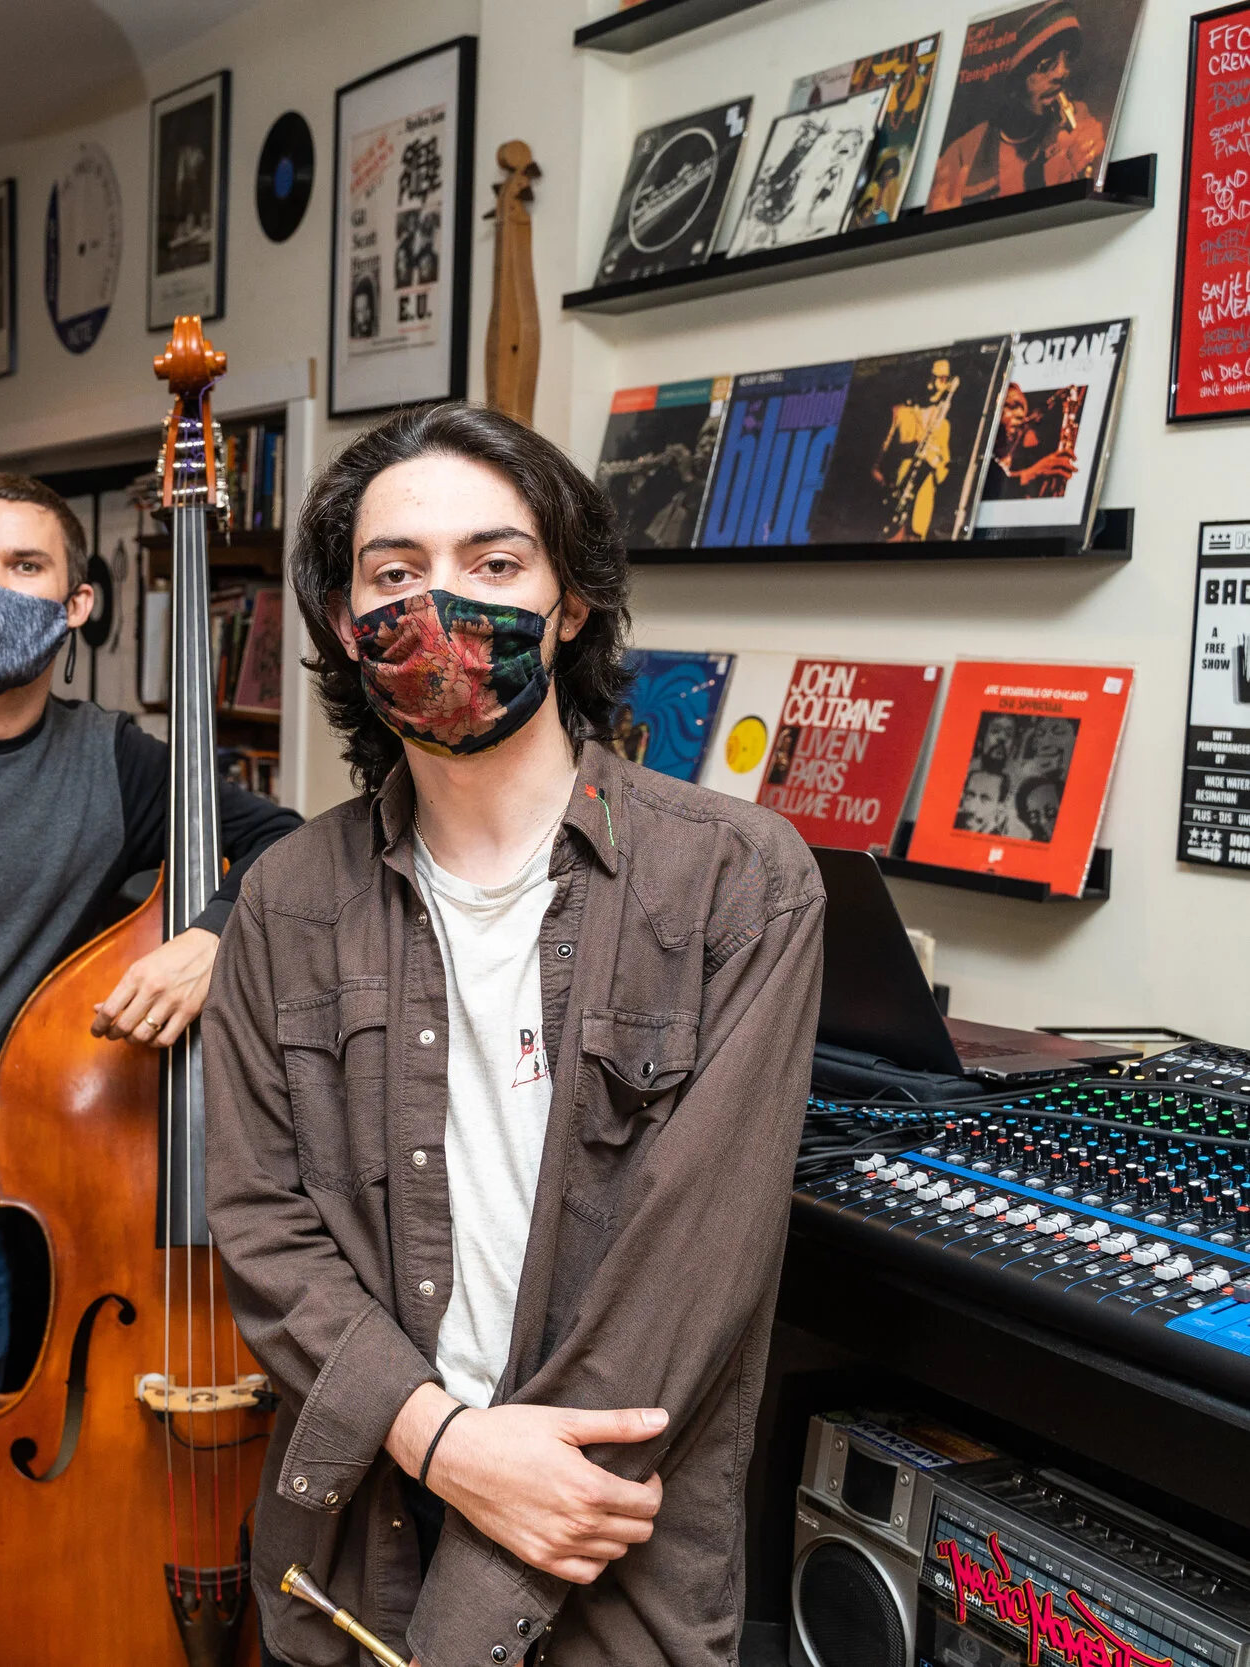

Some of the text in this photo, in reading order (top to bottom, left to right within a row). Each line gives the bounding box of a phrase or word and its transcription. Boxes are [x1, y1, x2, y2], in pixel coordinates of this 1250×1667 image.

[703, 396, 839, 547] blue
[1211, 627, 1218, 638] A
[1205, 642, 1226, 655] FREE
[1201, 659, 1230, 671] SHOW
[791, 663, 857, 697] JOHN
[783, 695, 894, 733] COLTRANE
[1212, 730, 1234, 741] WITH
[794, 727, 870, 763] LIVE IN
[1215, 753, 1227, 765] BY
[785, 758, 849, 793] PARIS
[1204, 775, 1225, 788] WADE
[1195, 789, 1238, 805] RESINATION
[761, 787, 881, 825] VOLUME TWO
[1192, 808, 1212, 822] PLUS
[1218, 811, 1233, 824] DJS
[1081, 1583, 1092, 1592] 100
[1102, 1593, 1112, 1602] 104
